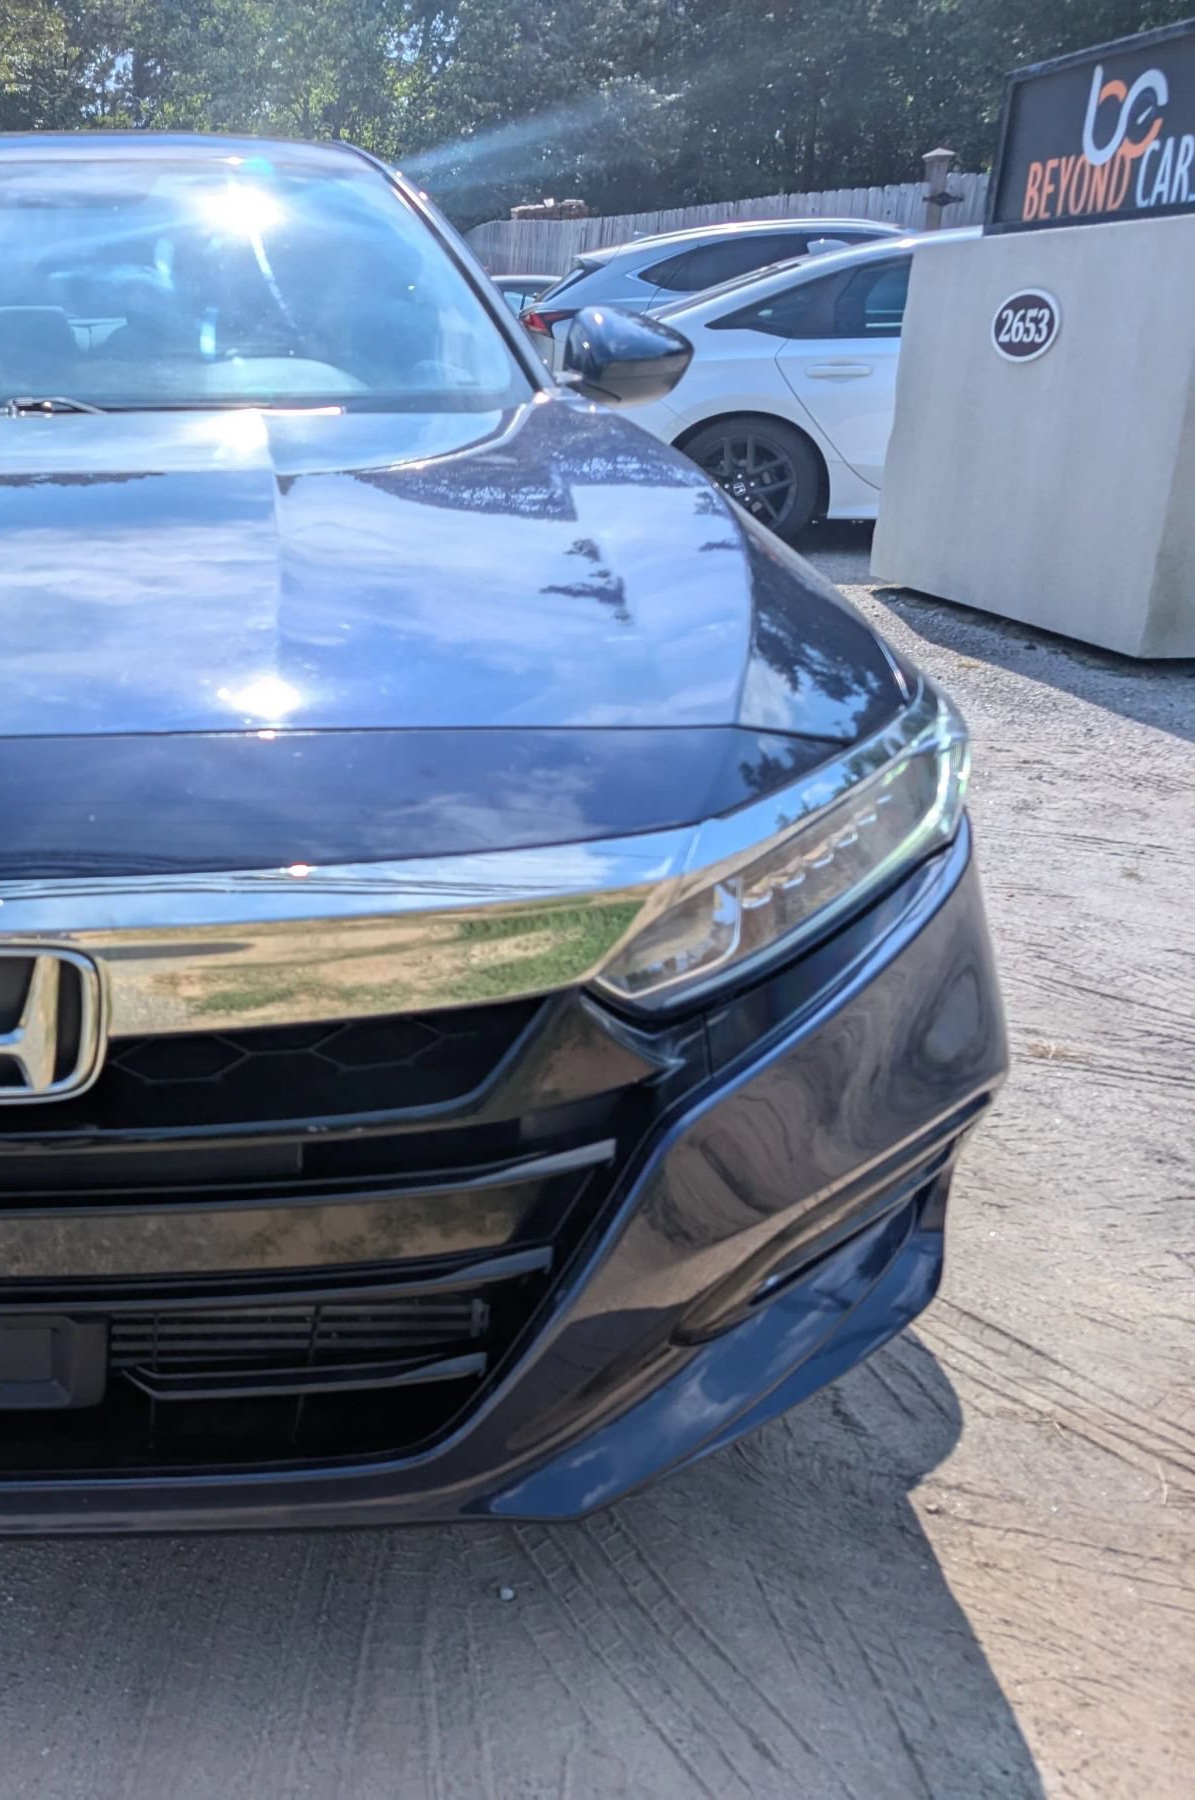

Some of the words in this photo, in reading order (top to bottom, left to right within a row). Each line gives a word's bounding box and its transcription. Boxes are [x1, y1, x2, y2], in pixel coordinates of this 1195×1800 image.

[1022, 152, 1132, 222] BEYOND
[1136, 133, 1195, 208] CAR
[998, 308, 1050, 343] 2653
